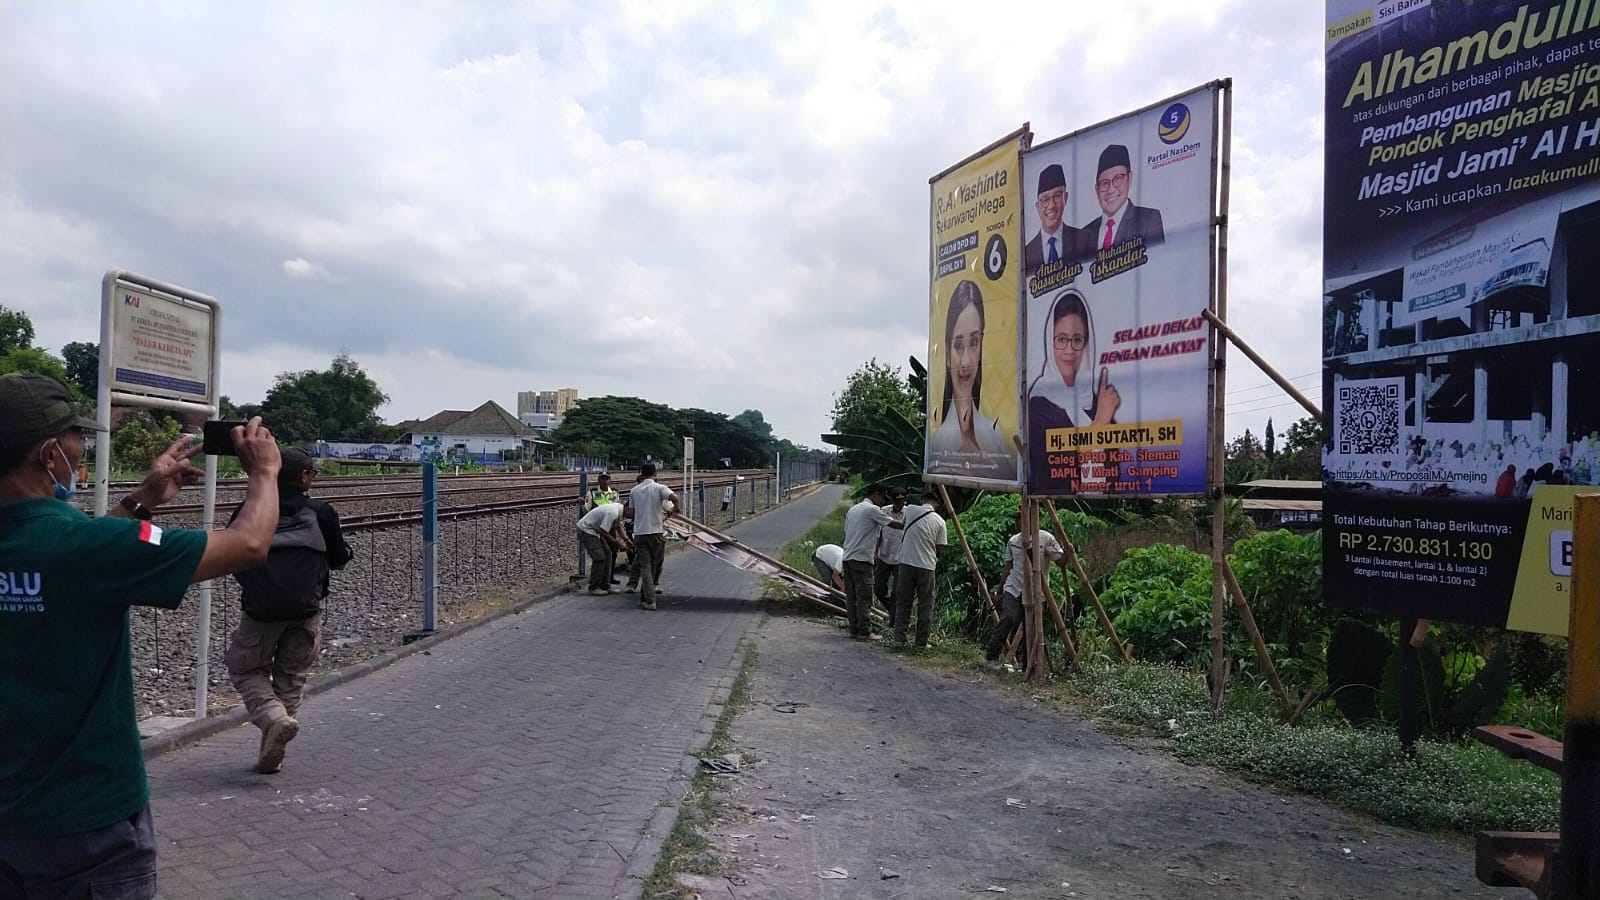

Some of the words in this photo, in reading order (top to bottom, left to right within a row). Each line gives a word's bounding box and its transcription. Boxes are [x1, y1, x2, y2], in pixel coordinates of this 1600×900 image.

[1379, 3, 1395, 19] Sisi
[1327, 15, 1372, 40] Tampakan
[1353, 106, 1373, 123] atas
[1375, 91, 1425, 116] dukungan
[1427, 83, 1449, 100] dari
[1452, 68, 1502, 93] berbagai
[1505, 56, 1543, 78] pihak,
[1546, 41, 1585, 65] dapat
[1170, 111, 1178, 124] 5
[1359, 89, 1512, 148] Pembangunan
[1368, 131, 1446, 167] Pondok
[1450, 92, 1575, 145] Penghafal
[1147, 150, 1169, 165] Partai
[1170, 141, 1201, 158] NasDem
[1358, 157, 1443, 201] Masjid
[1531, 125, 1569, 160] Al
[959, 169, 1008, 204] Yashinta
[1406, 193, 1439, 213] Kami
[1442, 182, 1502, 205] ucapkan
[1505, 157, 1600, 192] Jazakumull
[936, 205, 978, 235] Sekarwangi
[979, 196, 1005, 217] Mega
[986, 221, 1005, 233] NOMOR
[940, 243, 957, 257] CALON
[957, 238, 969, 250] DPD
[989, 240, 1002, 273] 6
[1097, 236, 1143, 262] Muhaimin
[1037, 259, 1064, 279] Anies
[1090, 247, 1146, 278] Iskandar
[1030, 263, 1081, 293] Baswedan
[125, 294, 140, 308] KAI
[1113, 323, 1161, 344] SELALU
[1161, 317, 1207, 336] DEKAT
[1099, 345, 1151, 366] DENGAN
[1150, 337, 1207, 359] RAKYAT
[1051, 433, 1065, 450] Hj.
[1068, 431, 1093, 447] ISMI
[1096, 428, 1154, 445] SUTARTI,
[1158, 426, 1176, 440] SH
[1048, 454, 1075, 467] Caleg
[1078, 450, 1106, 464] DPRD
[1109, 450, 1134, 462] Kab.
[1137, 449, 1180, 461] Sleman
[1051, 467, 1079, 479] DAPIL
[1081, 467, 1090, 478] V
[1092, 465, 1118, 478] Mlati
[1127, 463, 1178, 478] Gamping
[1114, 480, 1141, 492] urut
[1145, 478, 1152, 492] 1
[1333, 514, 1356, 525] Total
[1358, 516, 1412, 529] Kebutuhan
[1414, 518, 1446, 533] Tahap
[1449, 520, 1513, 536] Berikutnya:
[1541, 506, 1573, 521] Mari
[1339, 532, 1363, 549] RP
[1367, 534, 1493, 560] 2.730.831.130
[1345, 554, 1350, 562] 3
[1351, 555, 1372, 565] Lantai
[1373, 556, 1414, 569] (basement,
[1414, 560, 1436, 571] lantai
[1437, 562, 1445, 572] 1,
[1446, 563, 1453, 572] &
[1455, 564, 1478, 574] lantai
[1479, 566, 1488, 577] 2)
[1354, 567, 1380, 578] dengan
[1381, 568, 1399, 579] total
[1400, 571, 1415, 581] luas
[1416, 573, 1438, 583] tanah
[1440, 575, 1462, 585] 1.100
[1463, 577, 1476, 587] m2
[0, 603, 45, 612] AMPING
